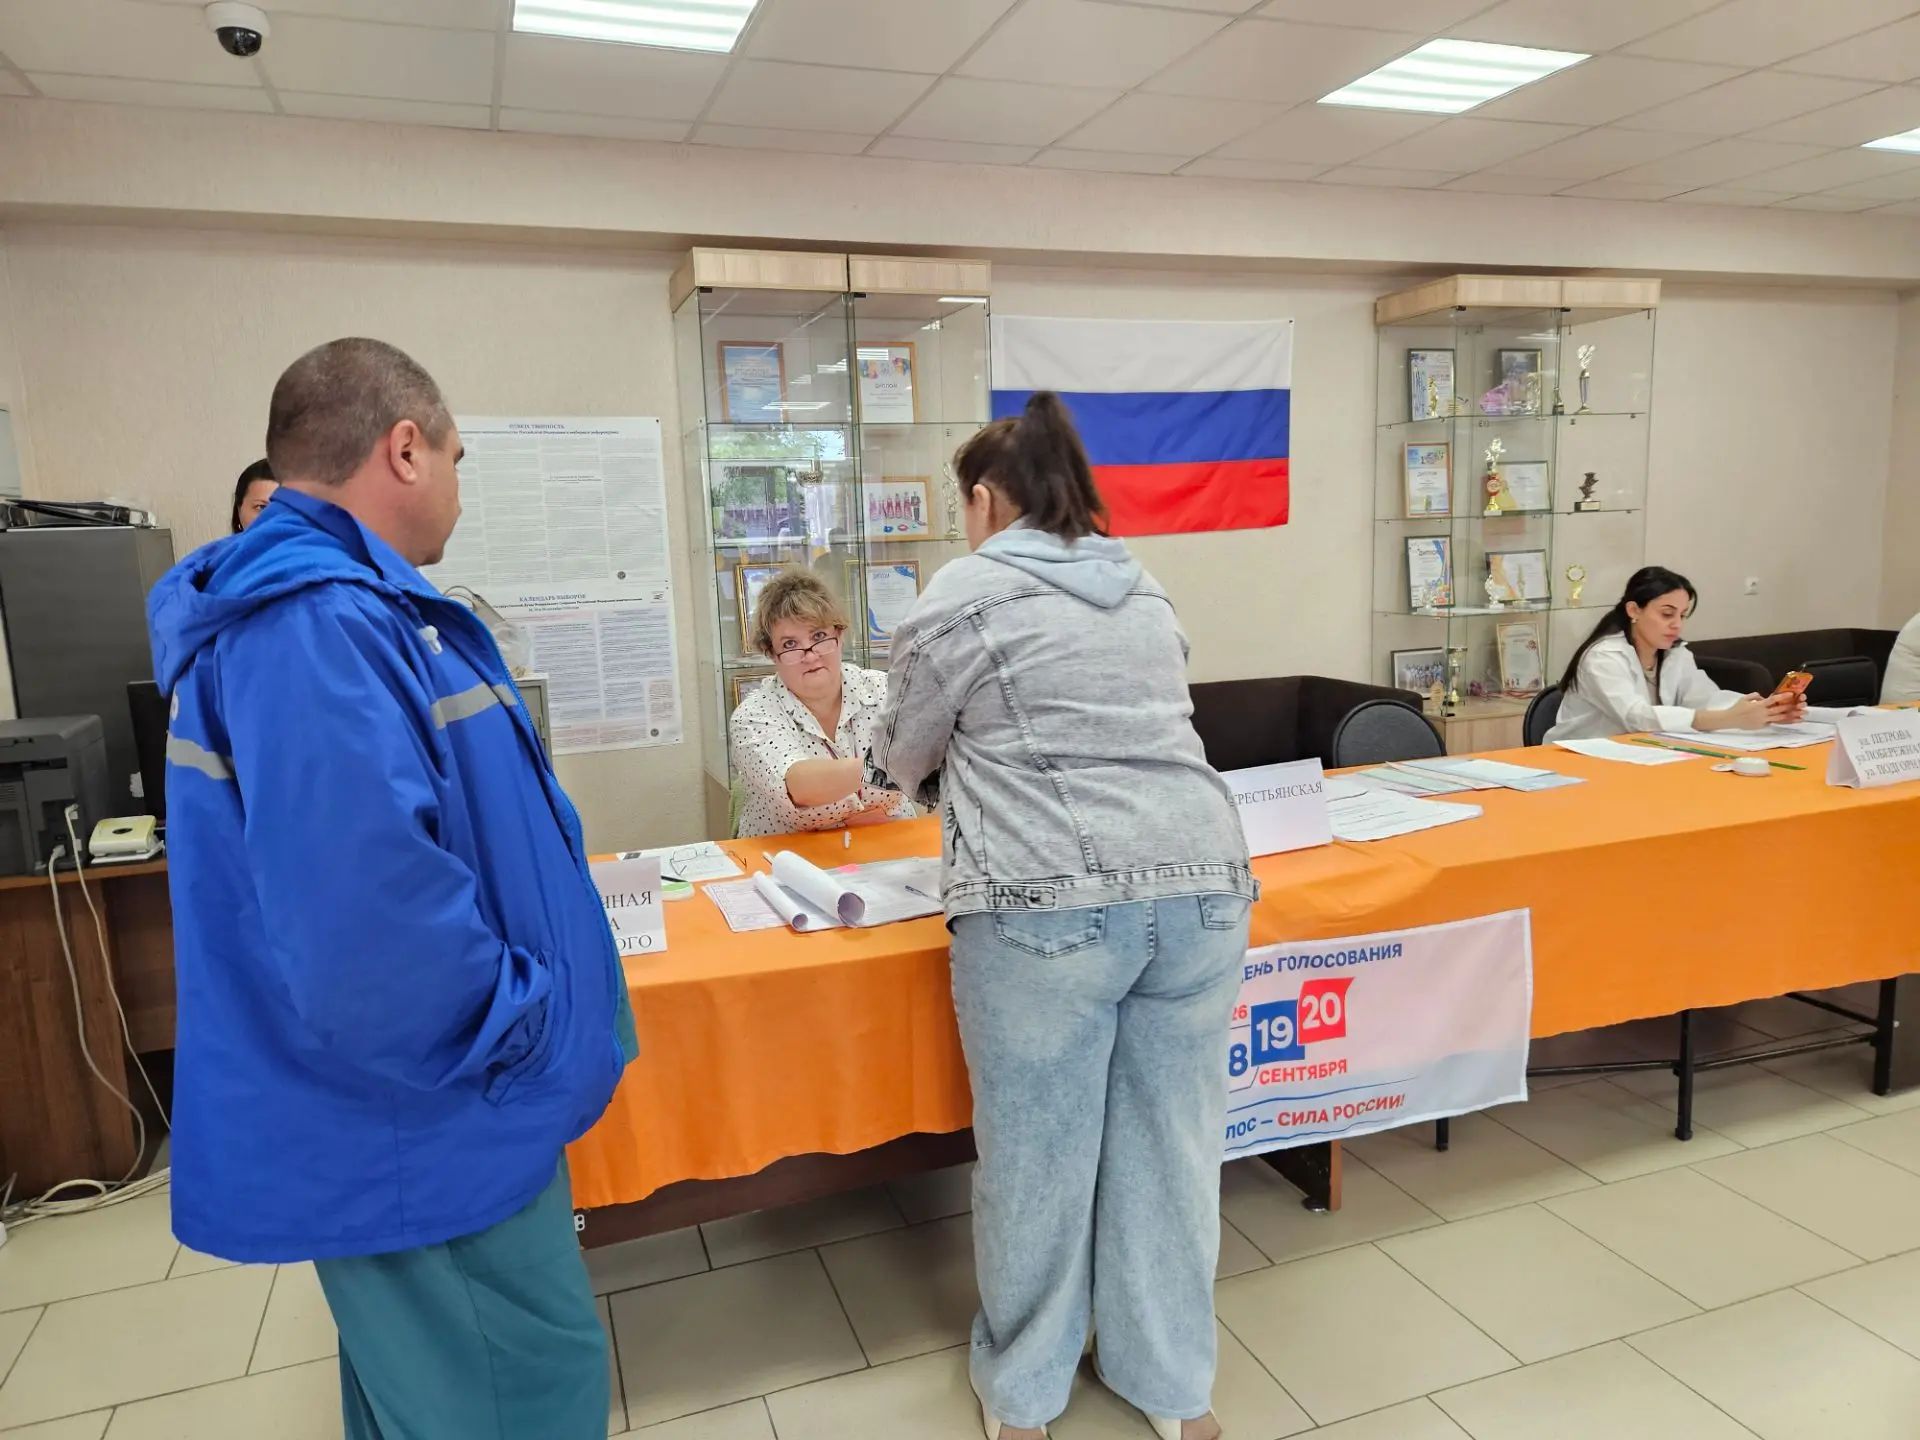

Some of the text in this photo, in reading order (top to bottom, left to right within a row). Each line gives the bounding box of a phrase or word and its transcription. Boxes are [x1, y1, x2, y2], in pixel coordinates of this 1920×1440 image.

[1235, 781, 1323, 805] РЕСТЬЯНСКАЯ
[1242, 943, 1403, 982] ЕНЬ ГОЛОСОВАНИЯ
[1256, 1015, 1294, 1052] 19
[1301, 991, 1342, 1030] 20
[1259, 1059, 1347, 1085] СЕНТЯБРЯ
[1226, 1117, 1257, 1140] ЛОС
[1277, 1109, 1329, 1127] СИЛА
[1333, 1094, 1405, 1121] РОССИИ!
